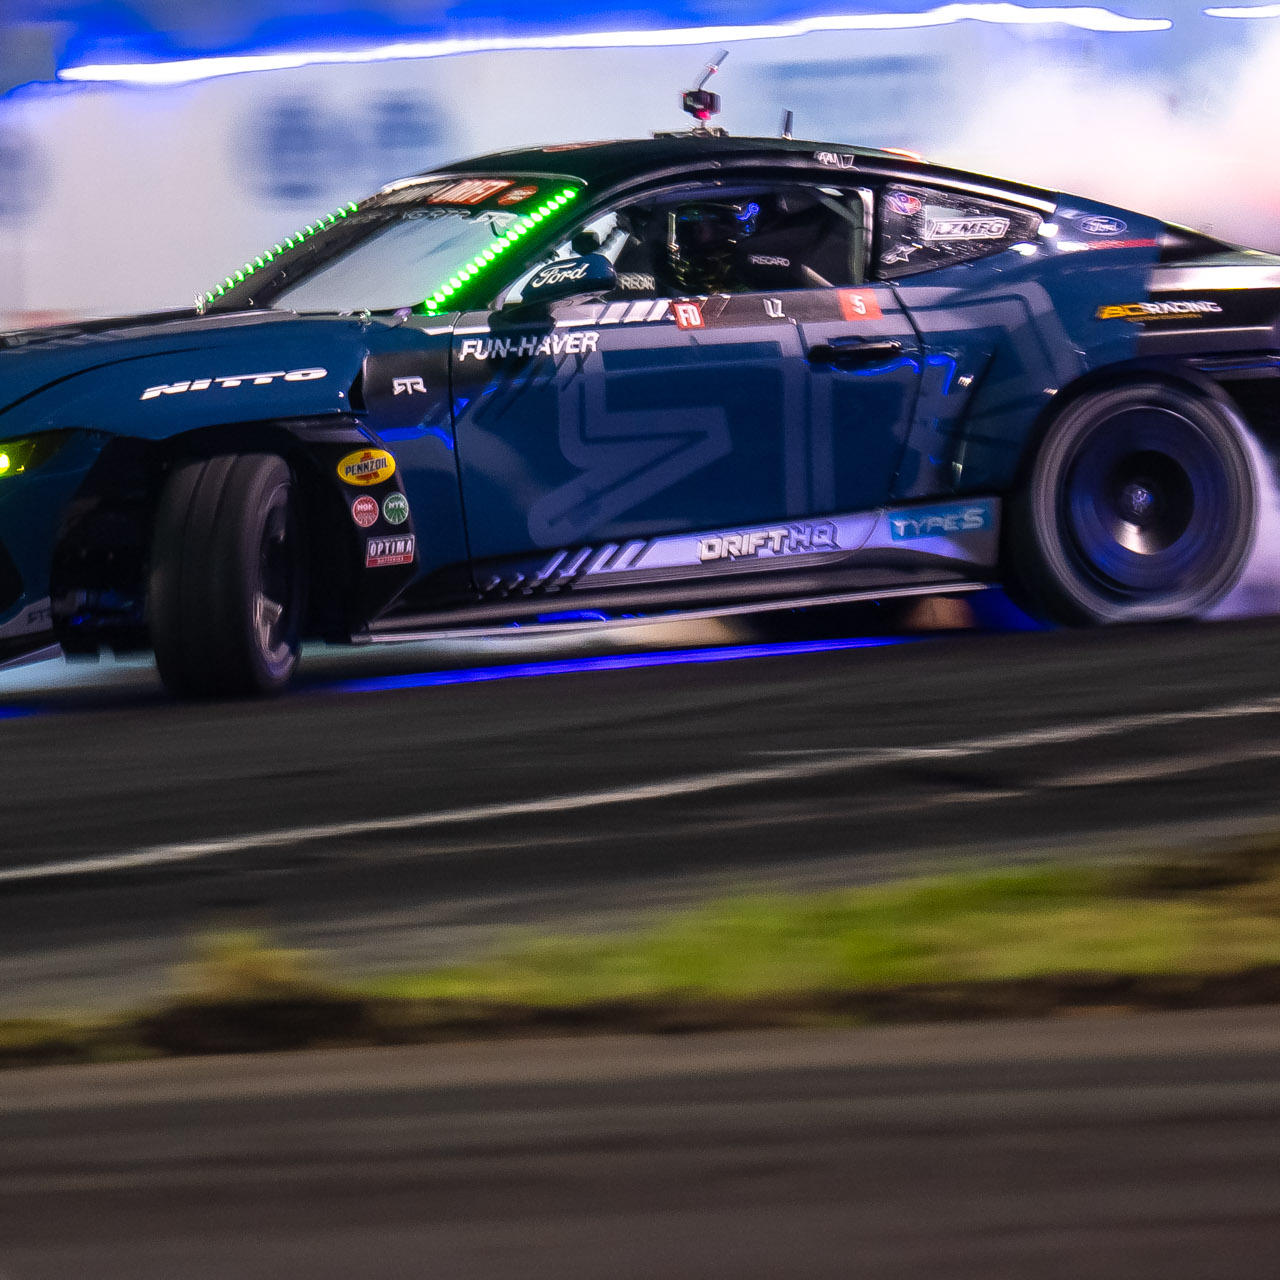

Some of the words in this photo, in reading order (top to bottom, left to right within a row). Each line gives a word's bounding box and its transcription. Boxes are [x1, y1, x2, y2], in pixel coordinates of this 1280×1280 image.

[531, 262, 590, 288] Ford
[458, 330, 600, 362] FUN-HAVER
[139, 366, 328, 401] NITTO
[345, 457, 388, 477] PENNZOIL
[369, 539, 413, 557] OPTIMA
